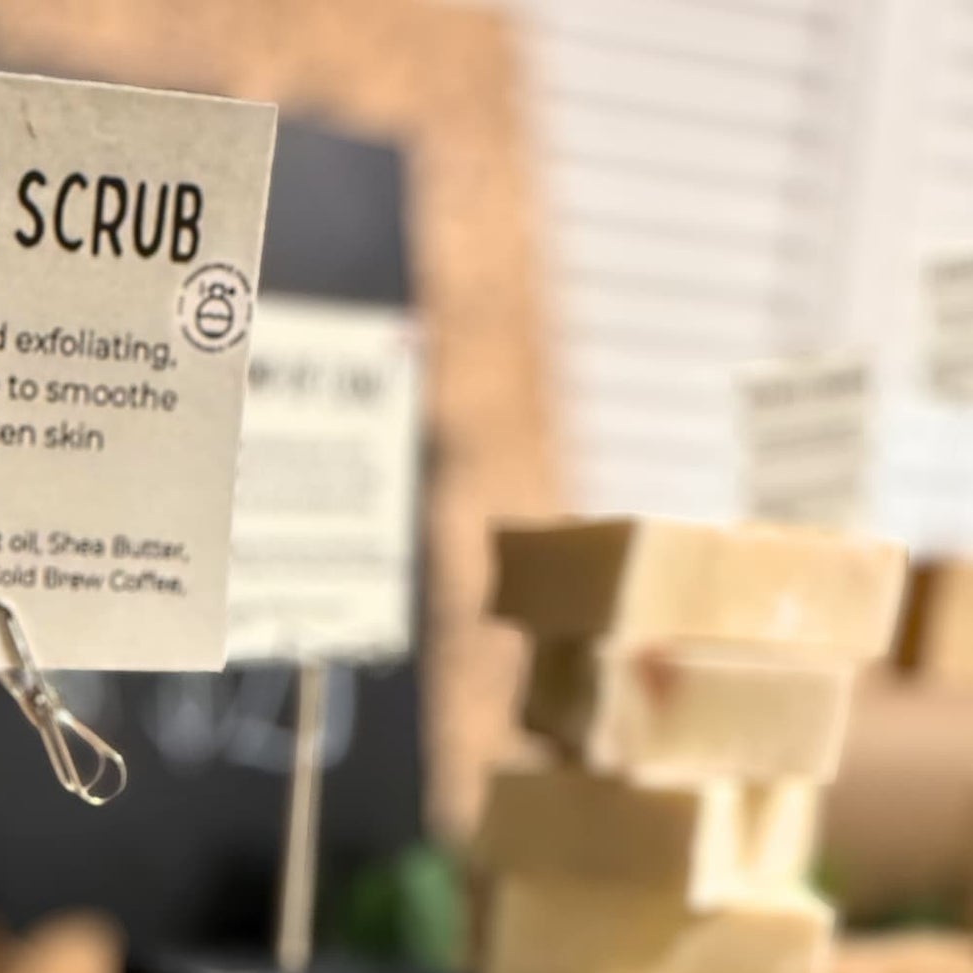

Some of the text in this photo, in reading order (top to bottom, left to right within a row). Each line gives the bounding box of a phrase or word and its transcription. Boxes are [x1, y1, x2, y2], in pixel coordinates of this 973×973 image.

[15, 169, 203, 263] SCRUB
[15, 327, 177, 371] exfoliating,
[8, 374, 39, 402] to
[45, 380, 178, 412] smoothe
[44, 420, 105, 451] skin
[8, 530, 43, 556] oil,
[48, 531, 106, 557] Shea
[43, 566, 104, 591] Brew
